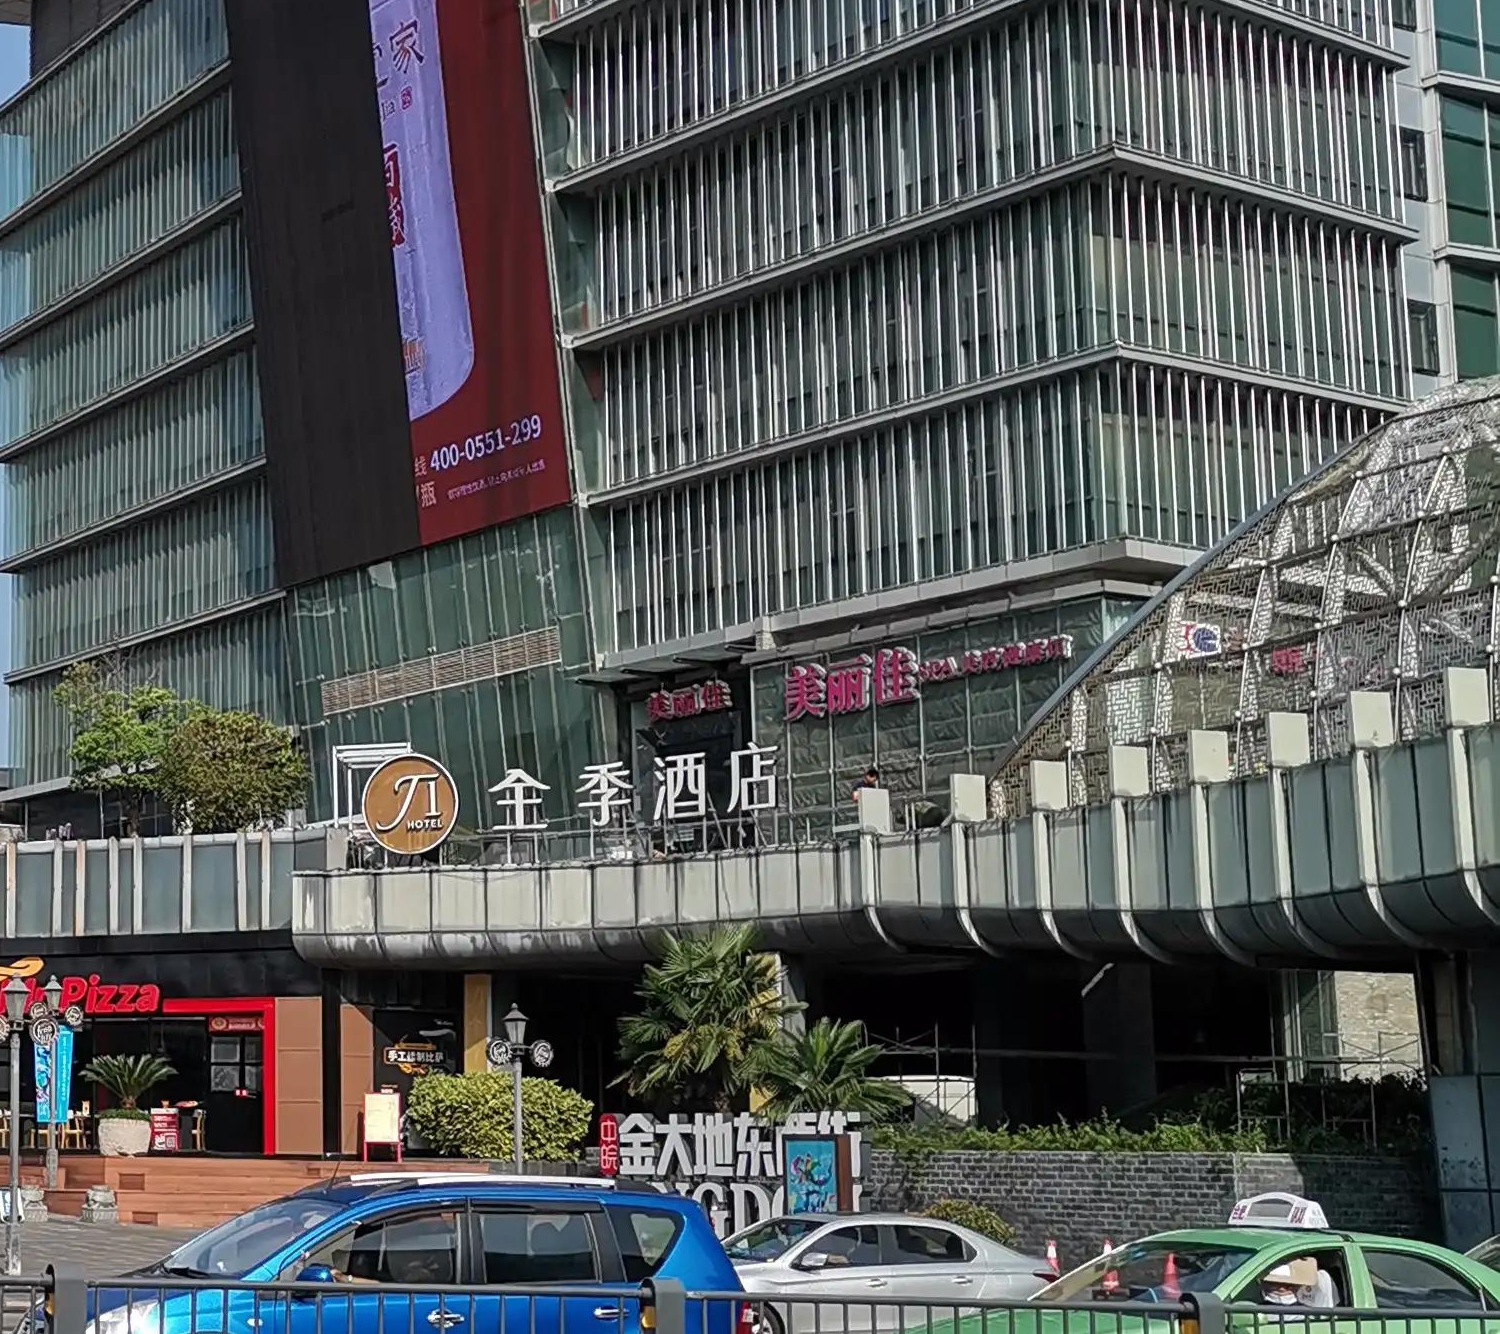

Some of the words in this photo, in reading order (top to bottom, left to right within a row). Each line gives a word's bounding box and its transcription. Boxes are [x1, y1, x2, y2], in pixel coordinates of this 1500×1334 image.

[430, 414, 542, 472] 400-0551-299
[416, 480, 437, 509] 瓶
[783, 646, 920, 722] 美丽佳
[487, 742, 780, 831] 全季酒店
[406, 819, 444, 832] HOTEL
[59, 974, 161, 1013] Pizza
